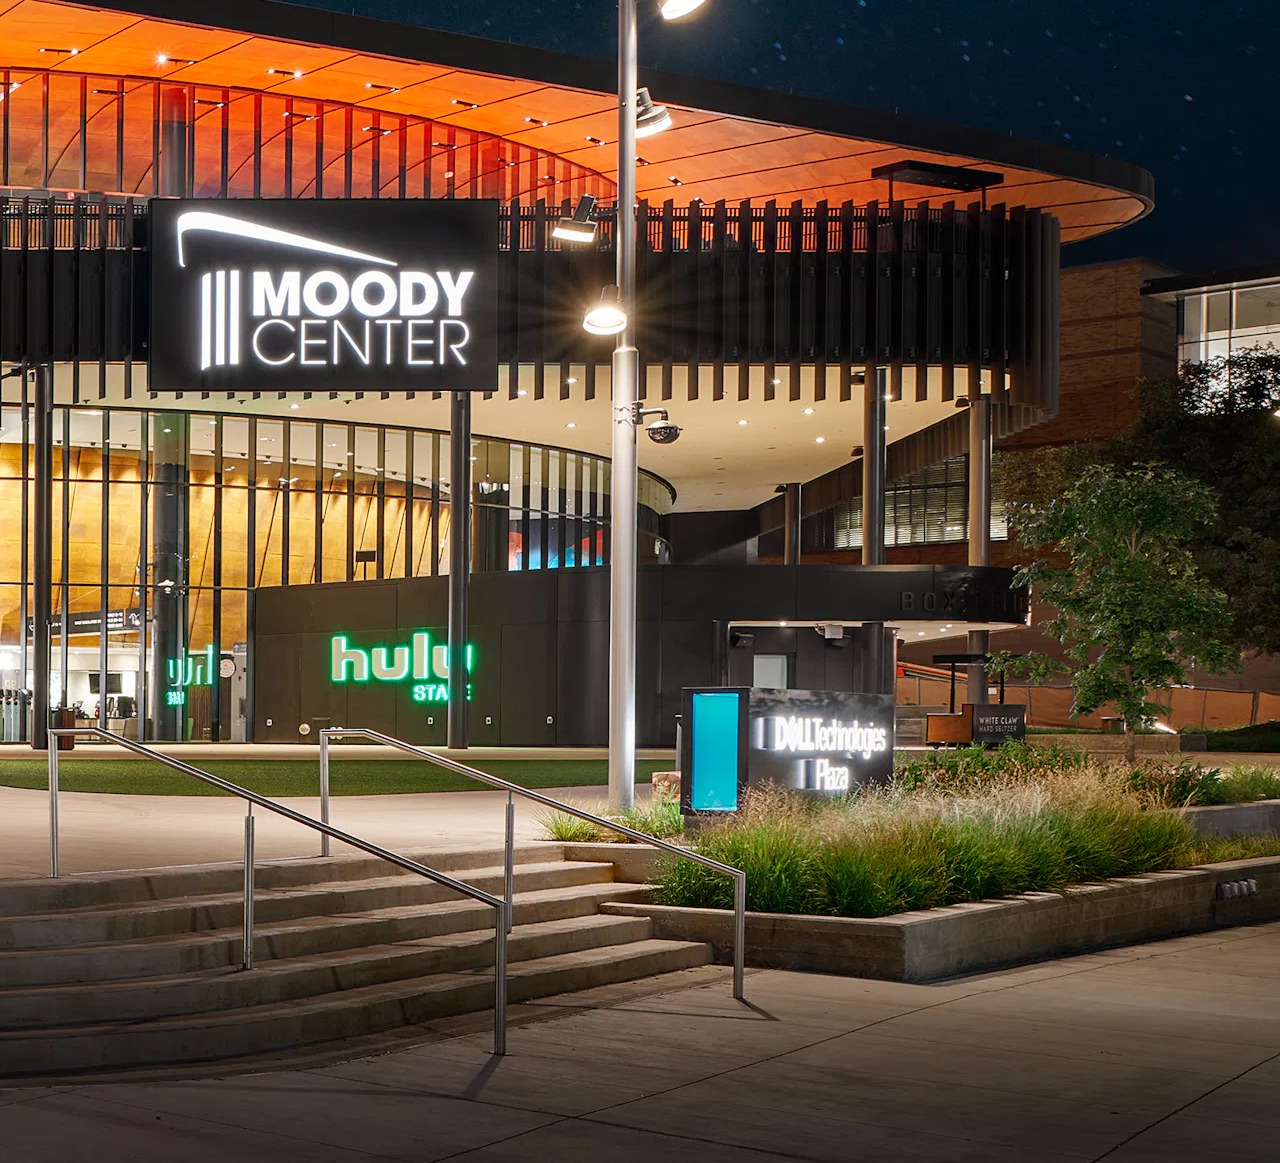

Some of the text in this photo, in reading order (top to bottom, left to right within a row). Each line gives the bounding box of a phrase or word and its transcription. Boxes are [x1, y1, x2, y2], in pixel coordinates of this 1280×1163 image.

[252, 270, 475, 317] MOODY
[252, 319, 470, 366] CENTER
[901, 591, 957, 611] BOX
[413, 685, 471, 701] STA
[979, 716, 999, 725] WHITE
[979, 725, 1017, 733] HARD SELTZER
[812, 717, 887, 760] Technologies
[816, 758, 848, 791] Plaza
